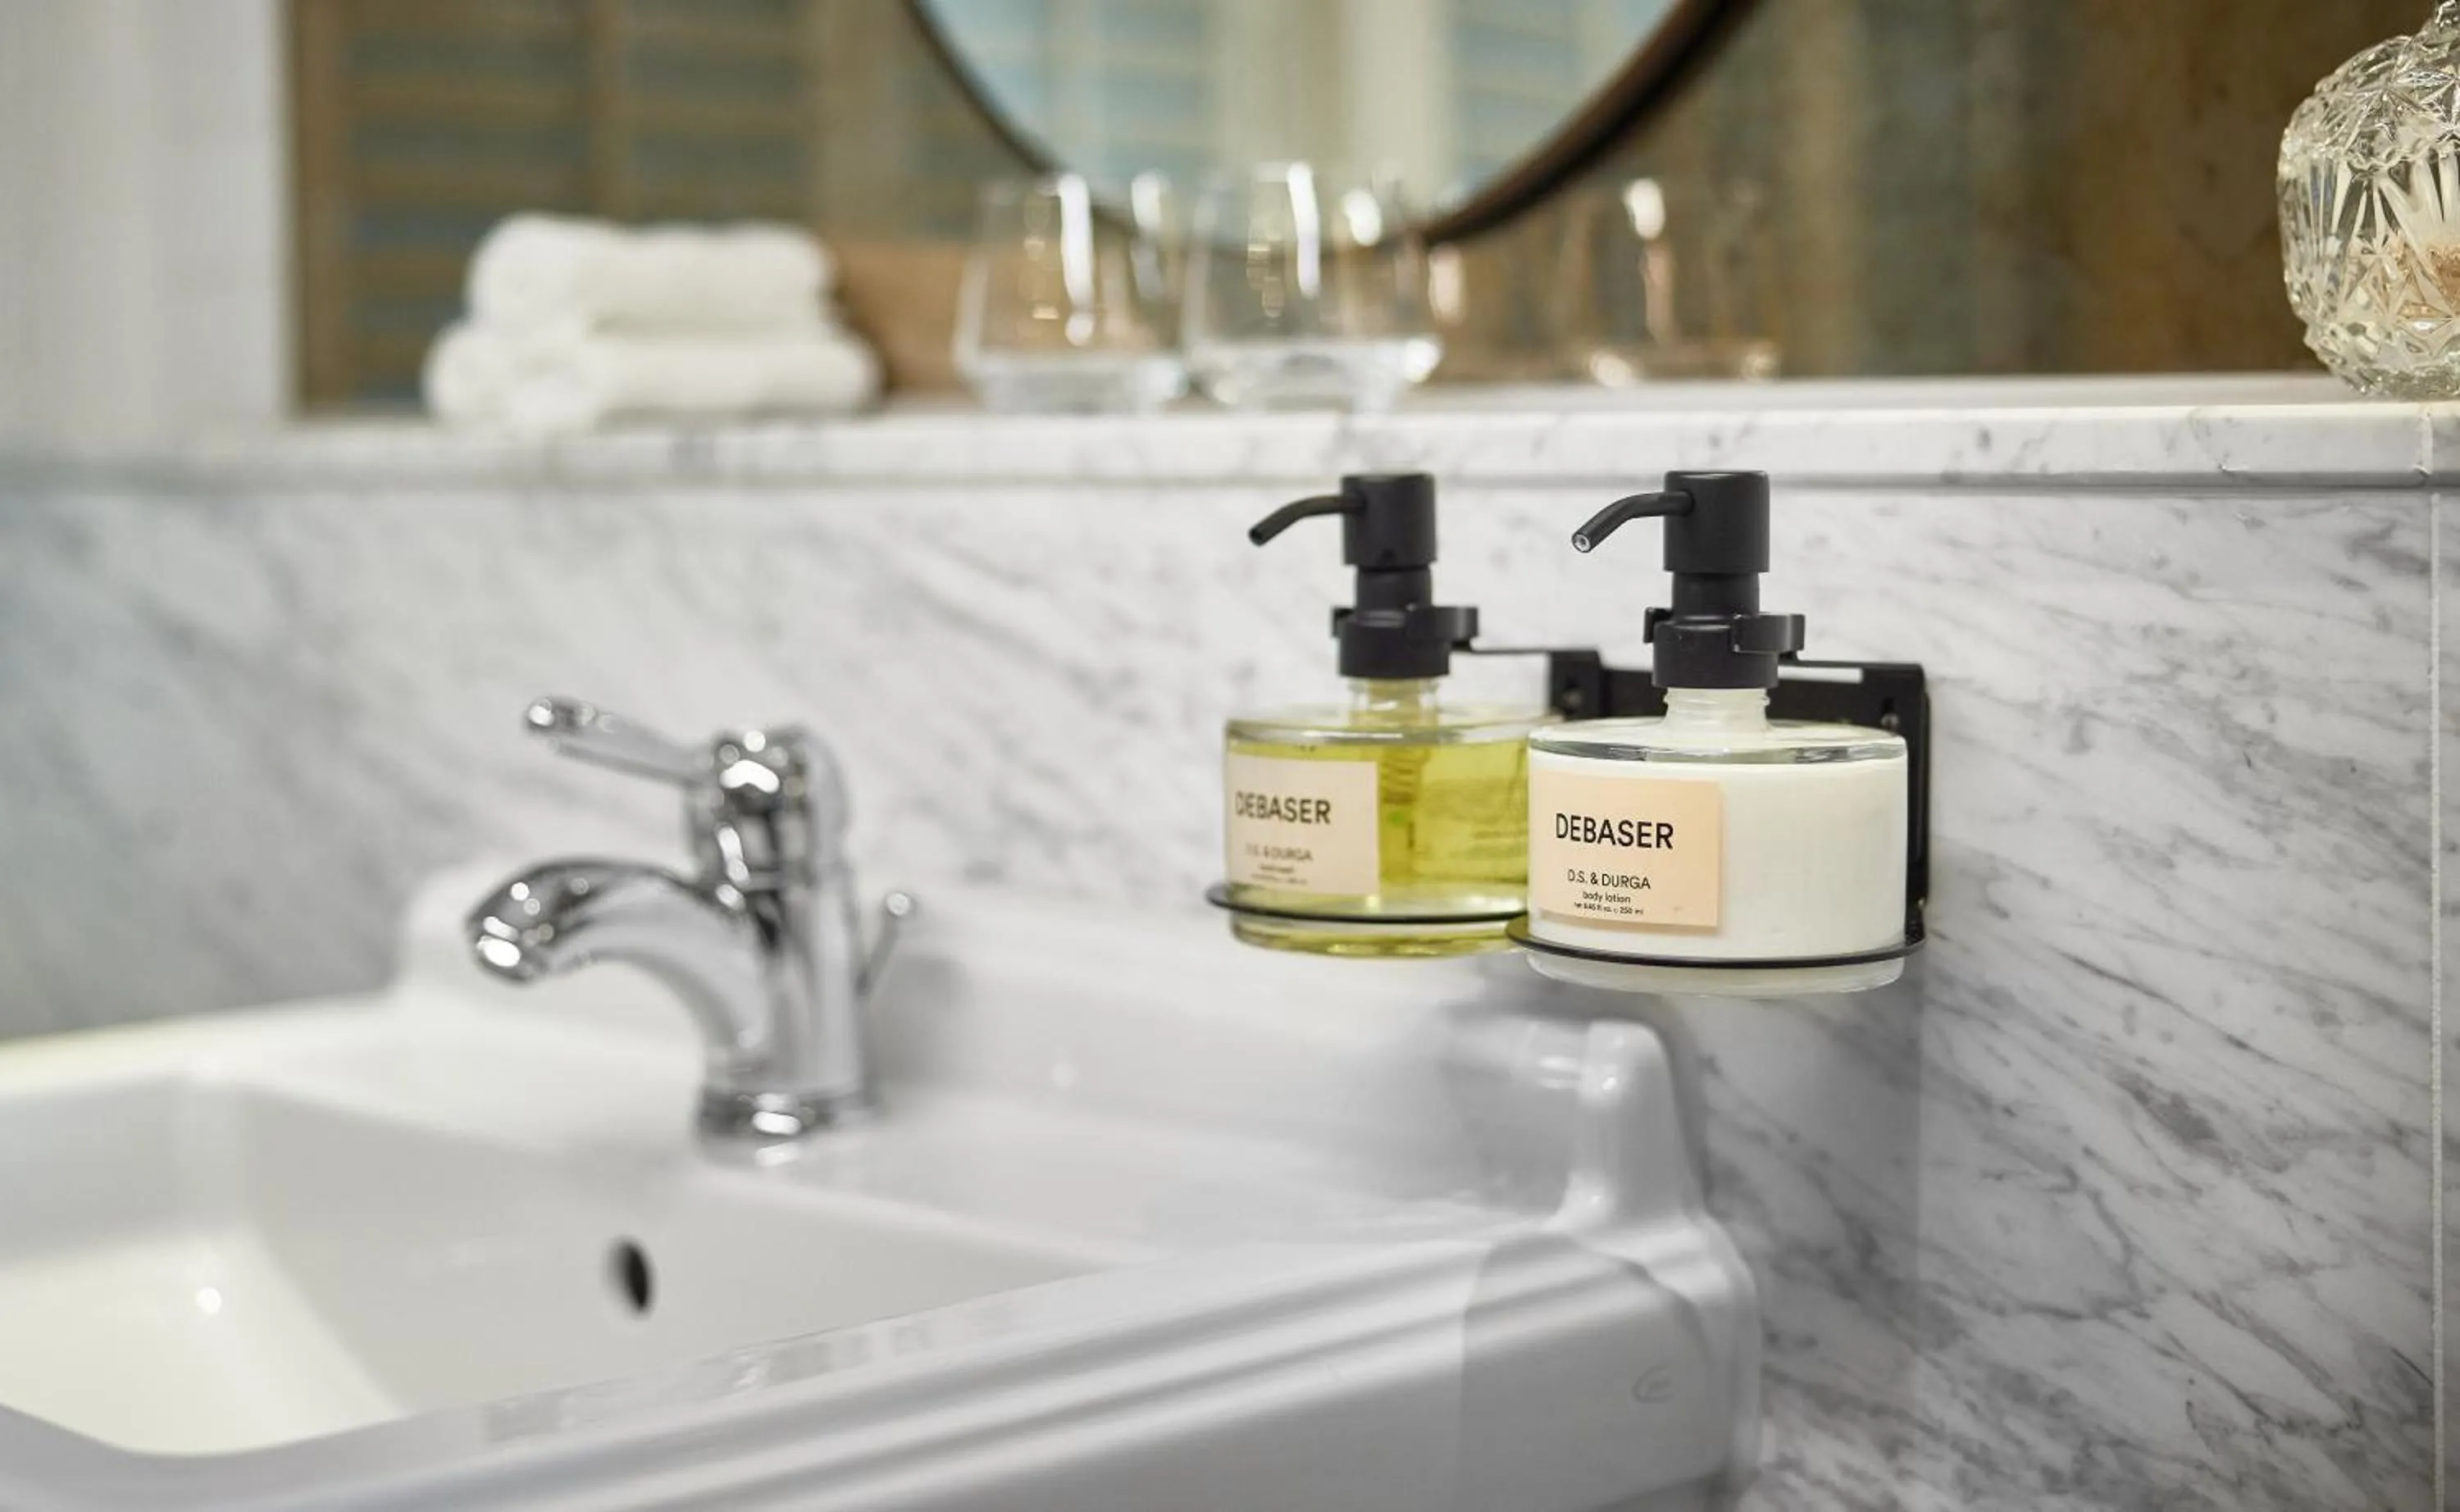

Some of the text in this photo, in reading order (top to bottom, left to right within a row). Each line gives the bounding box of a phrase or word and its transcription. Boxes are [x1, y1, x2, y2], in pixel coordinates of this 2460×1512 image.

[1236, 790, 1331, 824] DEBASER
[1556, 813, 1674, 849] DEBASER
[1568, 869, 1651, 890] D.S. & DURGA
[1583, 891, 1631, 904] body lotion
